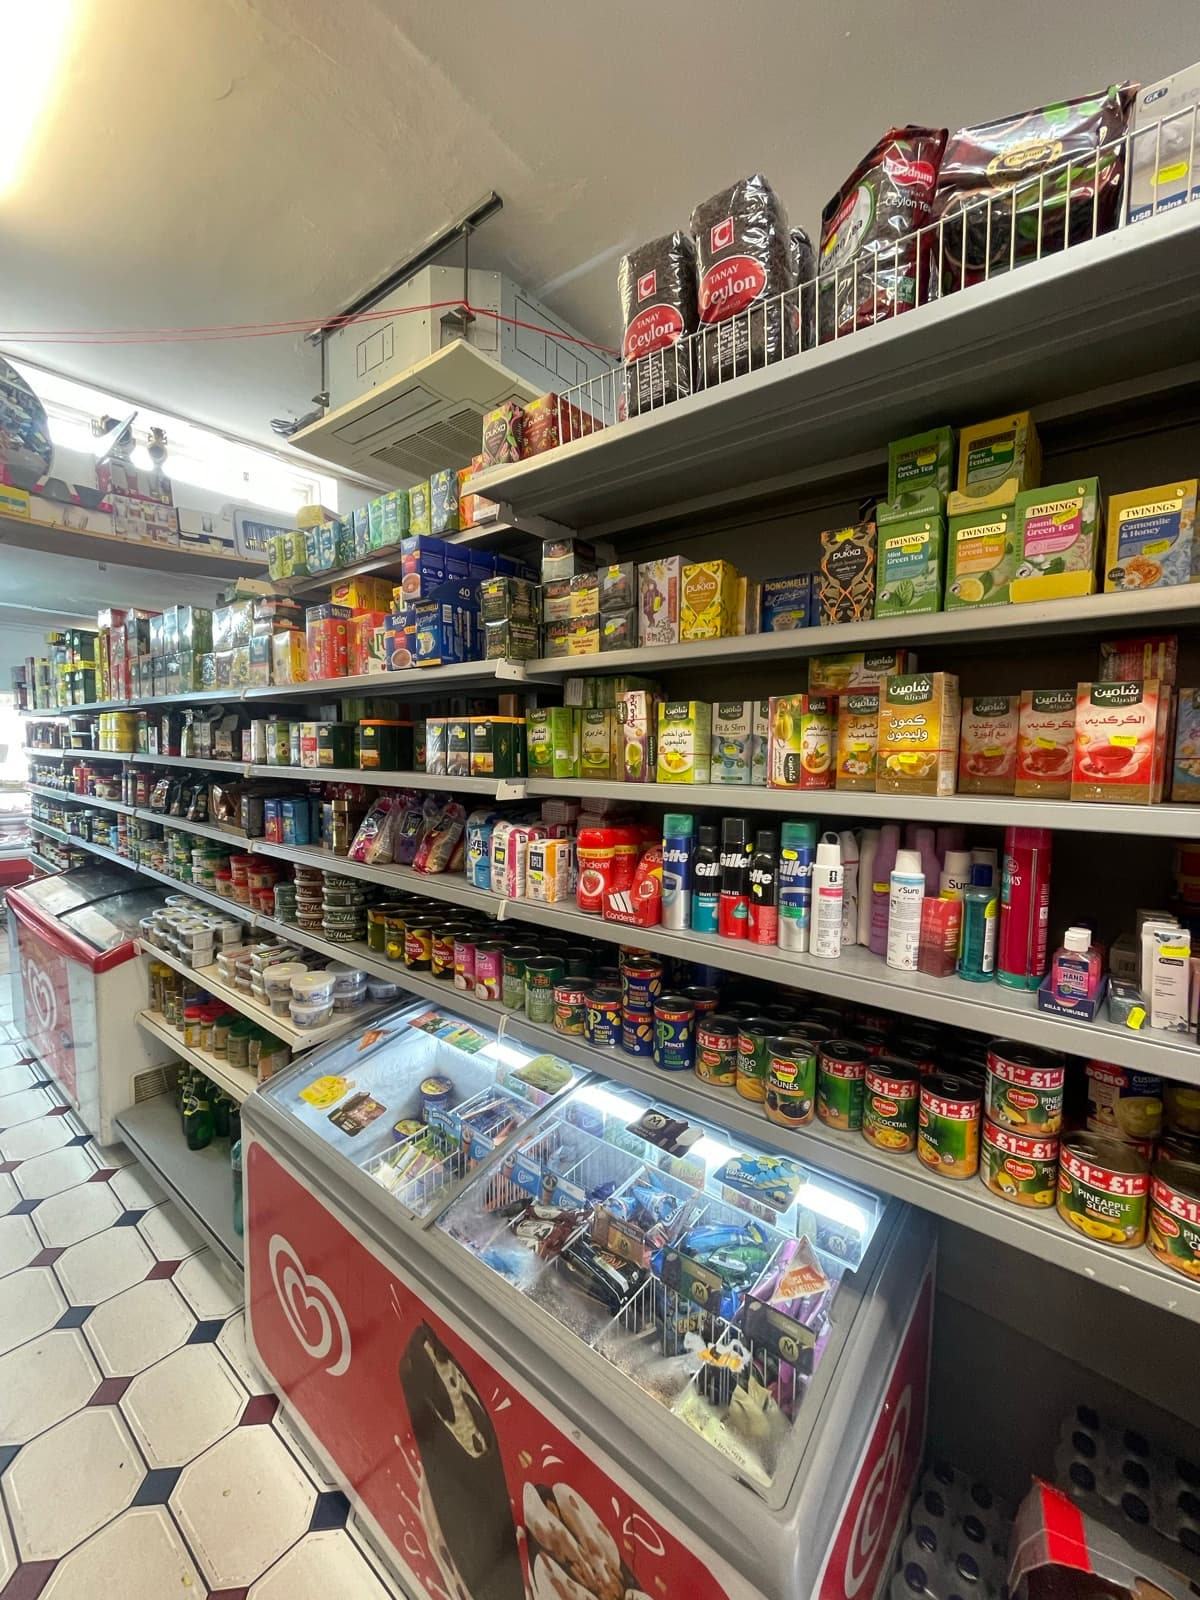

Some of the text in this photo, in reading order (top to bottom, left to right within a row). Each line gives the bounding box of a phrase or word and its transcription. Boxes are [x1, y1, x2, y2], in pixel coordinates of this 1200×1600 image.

[885, 198, 917, 211] Ceylon
[1131, 210, 1151, 223] USB
[710, 264, 739, 284] TANAY
[701, 275, 757, 310] Ceylon
[637, 311, 660, 329] TANAY
[628, 321, 674, 351] Ceylon
[485, 424, 506, 440] pukka
[1031, 502, 1077, 516] TWININGS
[1126, 503, 1176, 518] TWININGS
[1027, 519, 1054, 529] Jasmi
[1027, 523, 1075, 537] Green Tea
[1121, 518, 1172, 531] Camomile
[961, 526, 1001, 538] TWININGS
[1129, 527, 1161, 538] Honey
[889, 535, 925, 547] TWININGS
[833, 548, 861, 561] pukka
[958, 545, 1000, 557] Green Tea
[887, 553, 924, 565] Green Tea
[458, 586, 471, 598] 40
[686, 581, 716, 594] pukka
[391, 615, 407, 627] Tetley
[890, 680, 930, 695] شامين
[1094, 684, 1140, 699] شامين
[849, 697, 879, 709] شامين
[1035, 692, 1074, 705] شامين
[666, 705, 688, 715] شامين
[720, 705, 742, 714] شامين
[976, 702, 1007, 712] شامين
[890, 714, 927, 728] كمون
[1027, 720, 1075, 731] لكركديه
[1085, 715, 1145, 726] الكركديه
[729, 723, 746, 732] Slim
[887, 728, 928, 741] وليمون
[664, 850, 688, 862] ette
[695, 863, 720, 876] Gill
[949, 879, 967, 889] Sur
[903, 887, 920, 895] Sure
[606, 910, 635, 924] Canderel
[1063, 973, 1084, 982] HAND
[1044, 1003, 1089, 1019] KILLS VIRUSES
[770, 1076, 799, 1091] PRUNES
[878, 1116, 908, 1129] COCKTAIL
[1078, 1187, 1131, 1212] PINEAPPLE
[1086, 1200, 1121, 1217] SLICES
